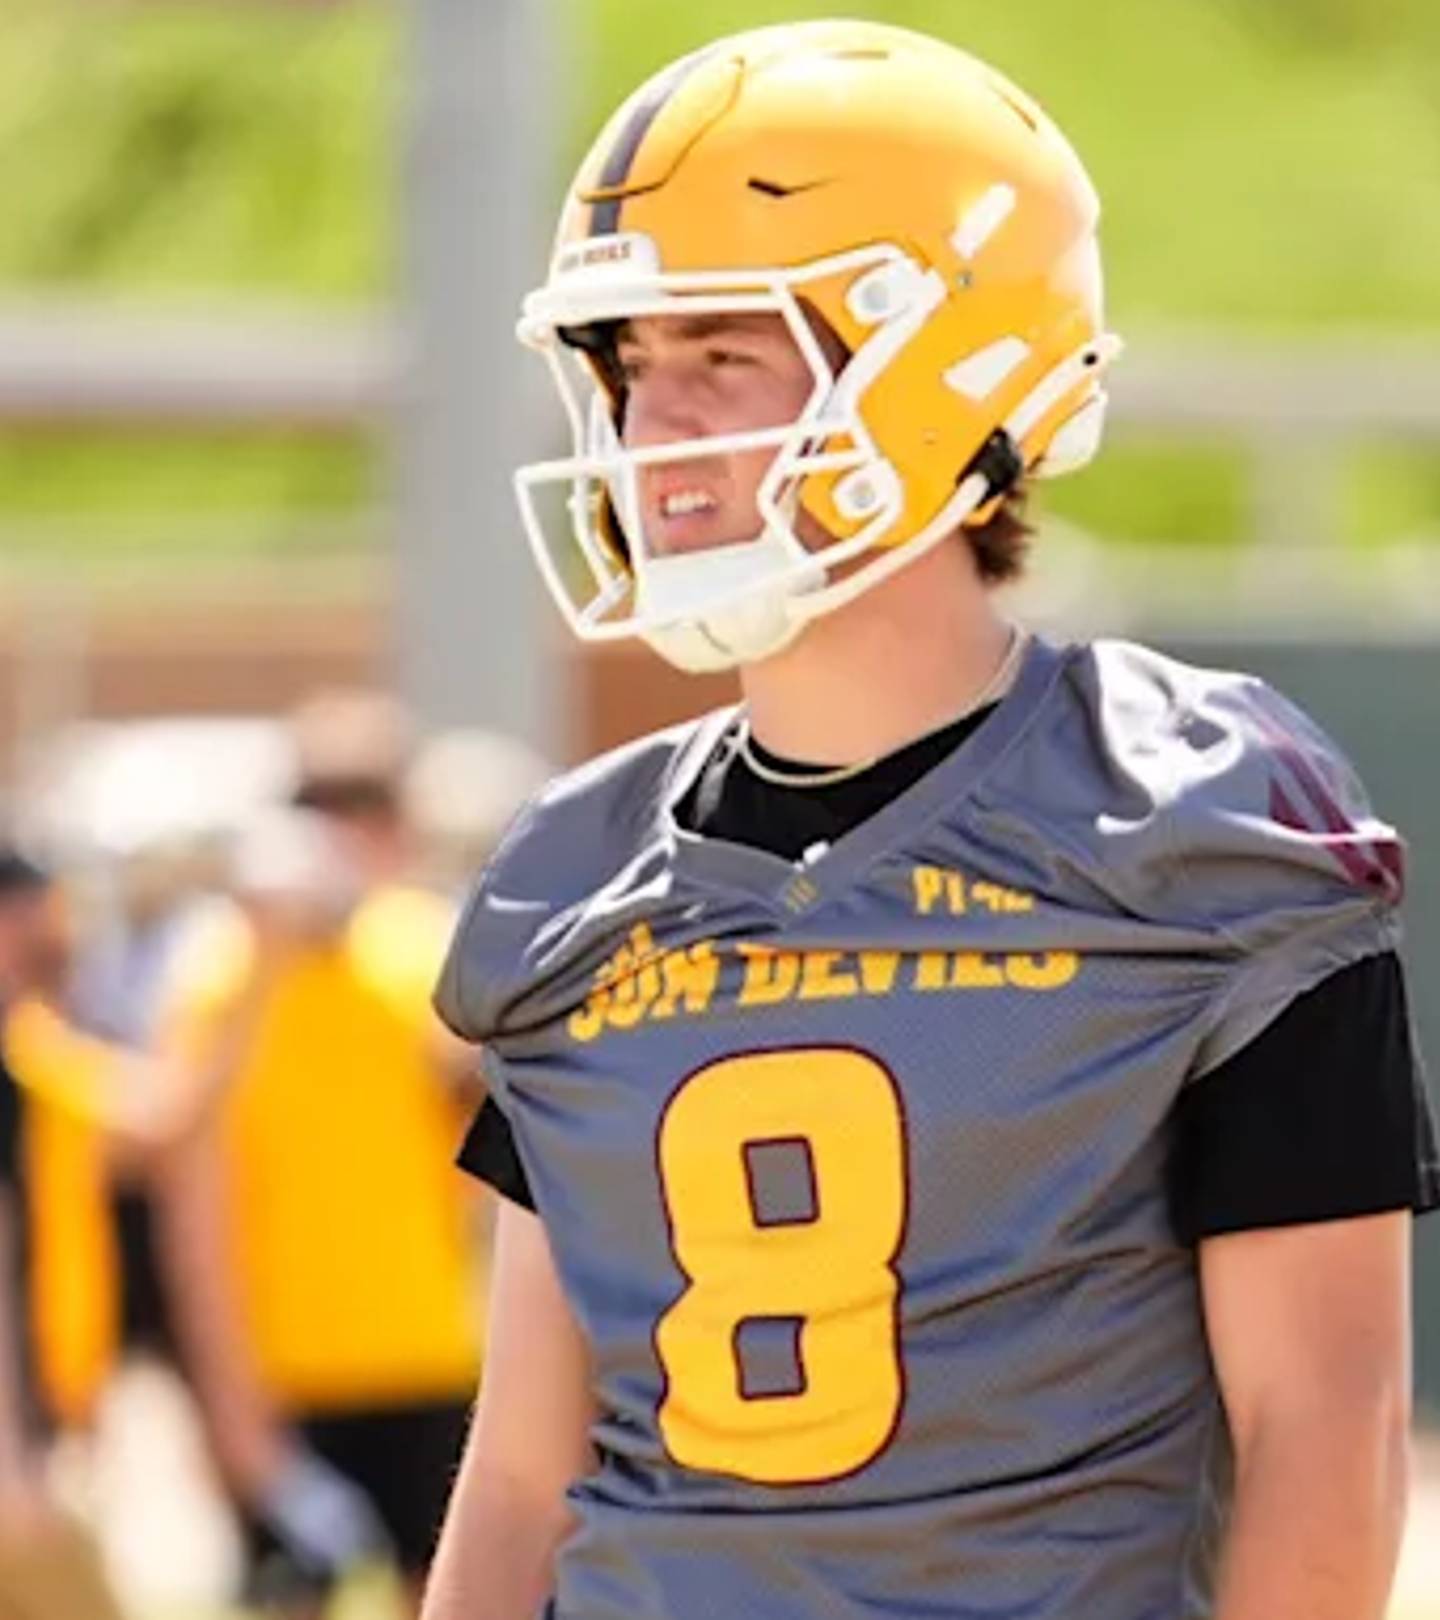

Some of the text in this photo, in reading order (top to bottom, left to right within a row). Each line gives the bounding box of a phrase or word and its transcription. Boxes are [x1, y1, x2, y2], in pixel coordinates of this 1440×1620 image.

[568, 920, 1080, 1042] SUN DEVILS
[653, 1042, 910, 1489] 8
